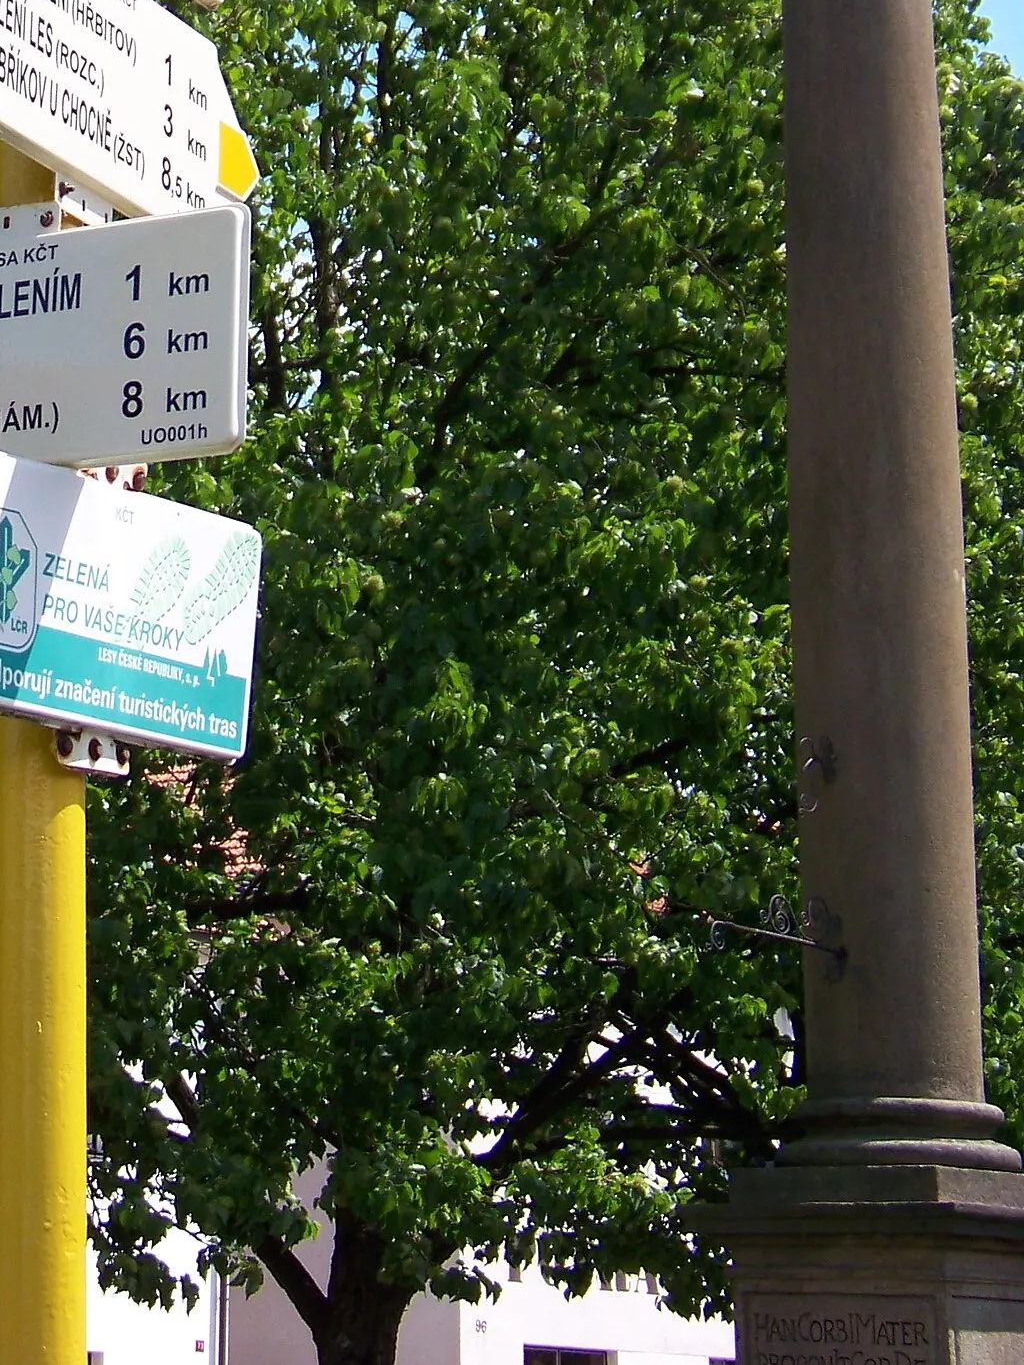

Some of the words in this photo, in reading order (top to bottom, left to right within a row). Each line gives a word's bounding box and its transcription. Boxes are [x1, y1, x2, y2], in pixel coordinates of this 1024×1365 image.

[30, 14, 53, 58] LES
[56, 38, 104, 97] (ROZC.)
[164, 104, 173, 137] 3
[187, 130, 207, 162] km
[165, 54, 173, 86] 1
[189, 79, 208, 111] km
[49, 83, 59, 117] U
[61, 87, 111, 153] CHOCNĚ
[113, 124, 145, 181] (ŽST)
[162, 156, 182, 198] 8,5
[187, 182, 205, 209] km
[22, 243, 59, 267] KČT
[125, 264, 141, 301] 1
[168, 269, 210, 297] km
[123, 322, 145, 359] 6
[167, 327, 208, 355] km
[122, 381, 144, 418] 8
[166, 386, 207, 413] km
[141, 423, 208, 445] UO001h
[115, 506, 134, 525] KČT
[43, 553, 109, 592] ZELENÁ
[43, 594, 78, 624] PRO
[84, 605, 125, 635] VAŠE
[129, 619, 185, 651] KROKY
[98, 647, 118, 665] LESY
[118, 649, 142, 670] ČESKÉ
[55, 679, 116, 709] značení
[119, 689, 205, 732] turistických
[209, 713, 237, 739] tras
